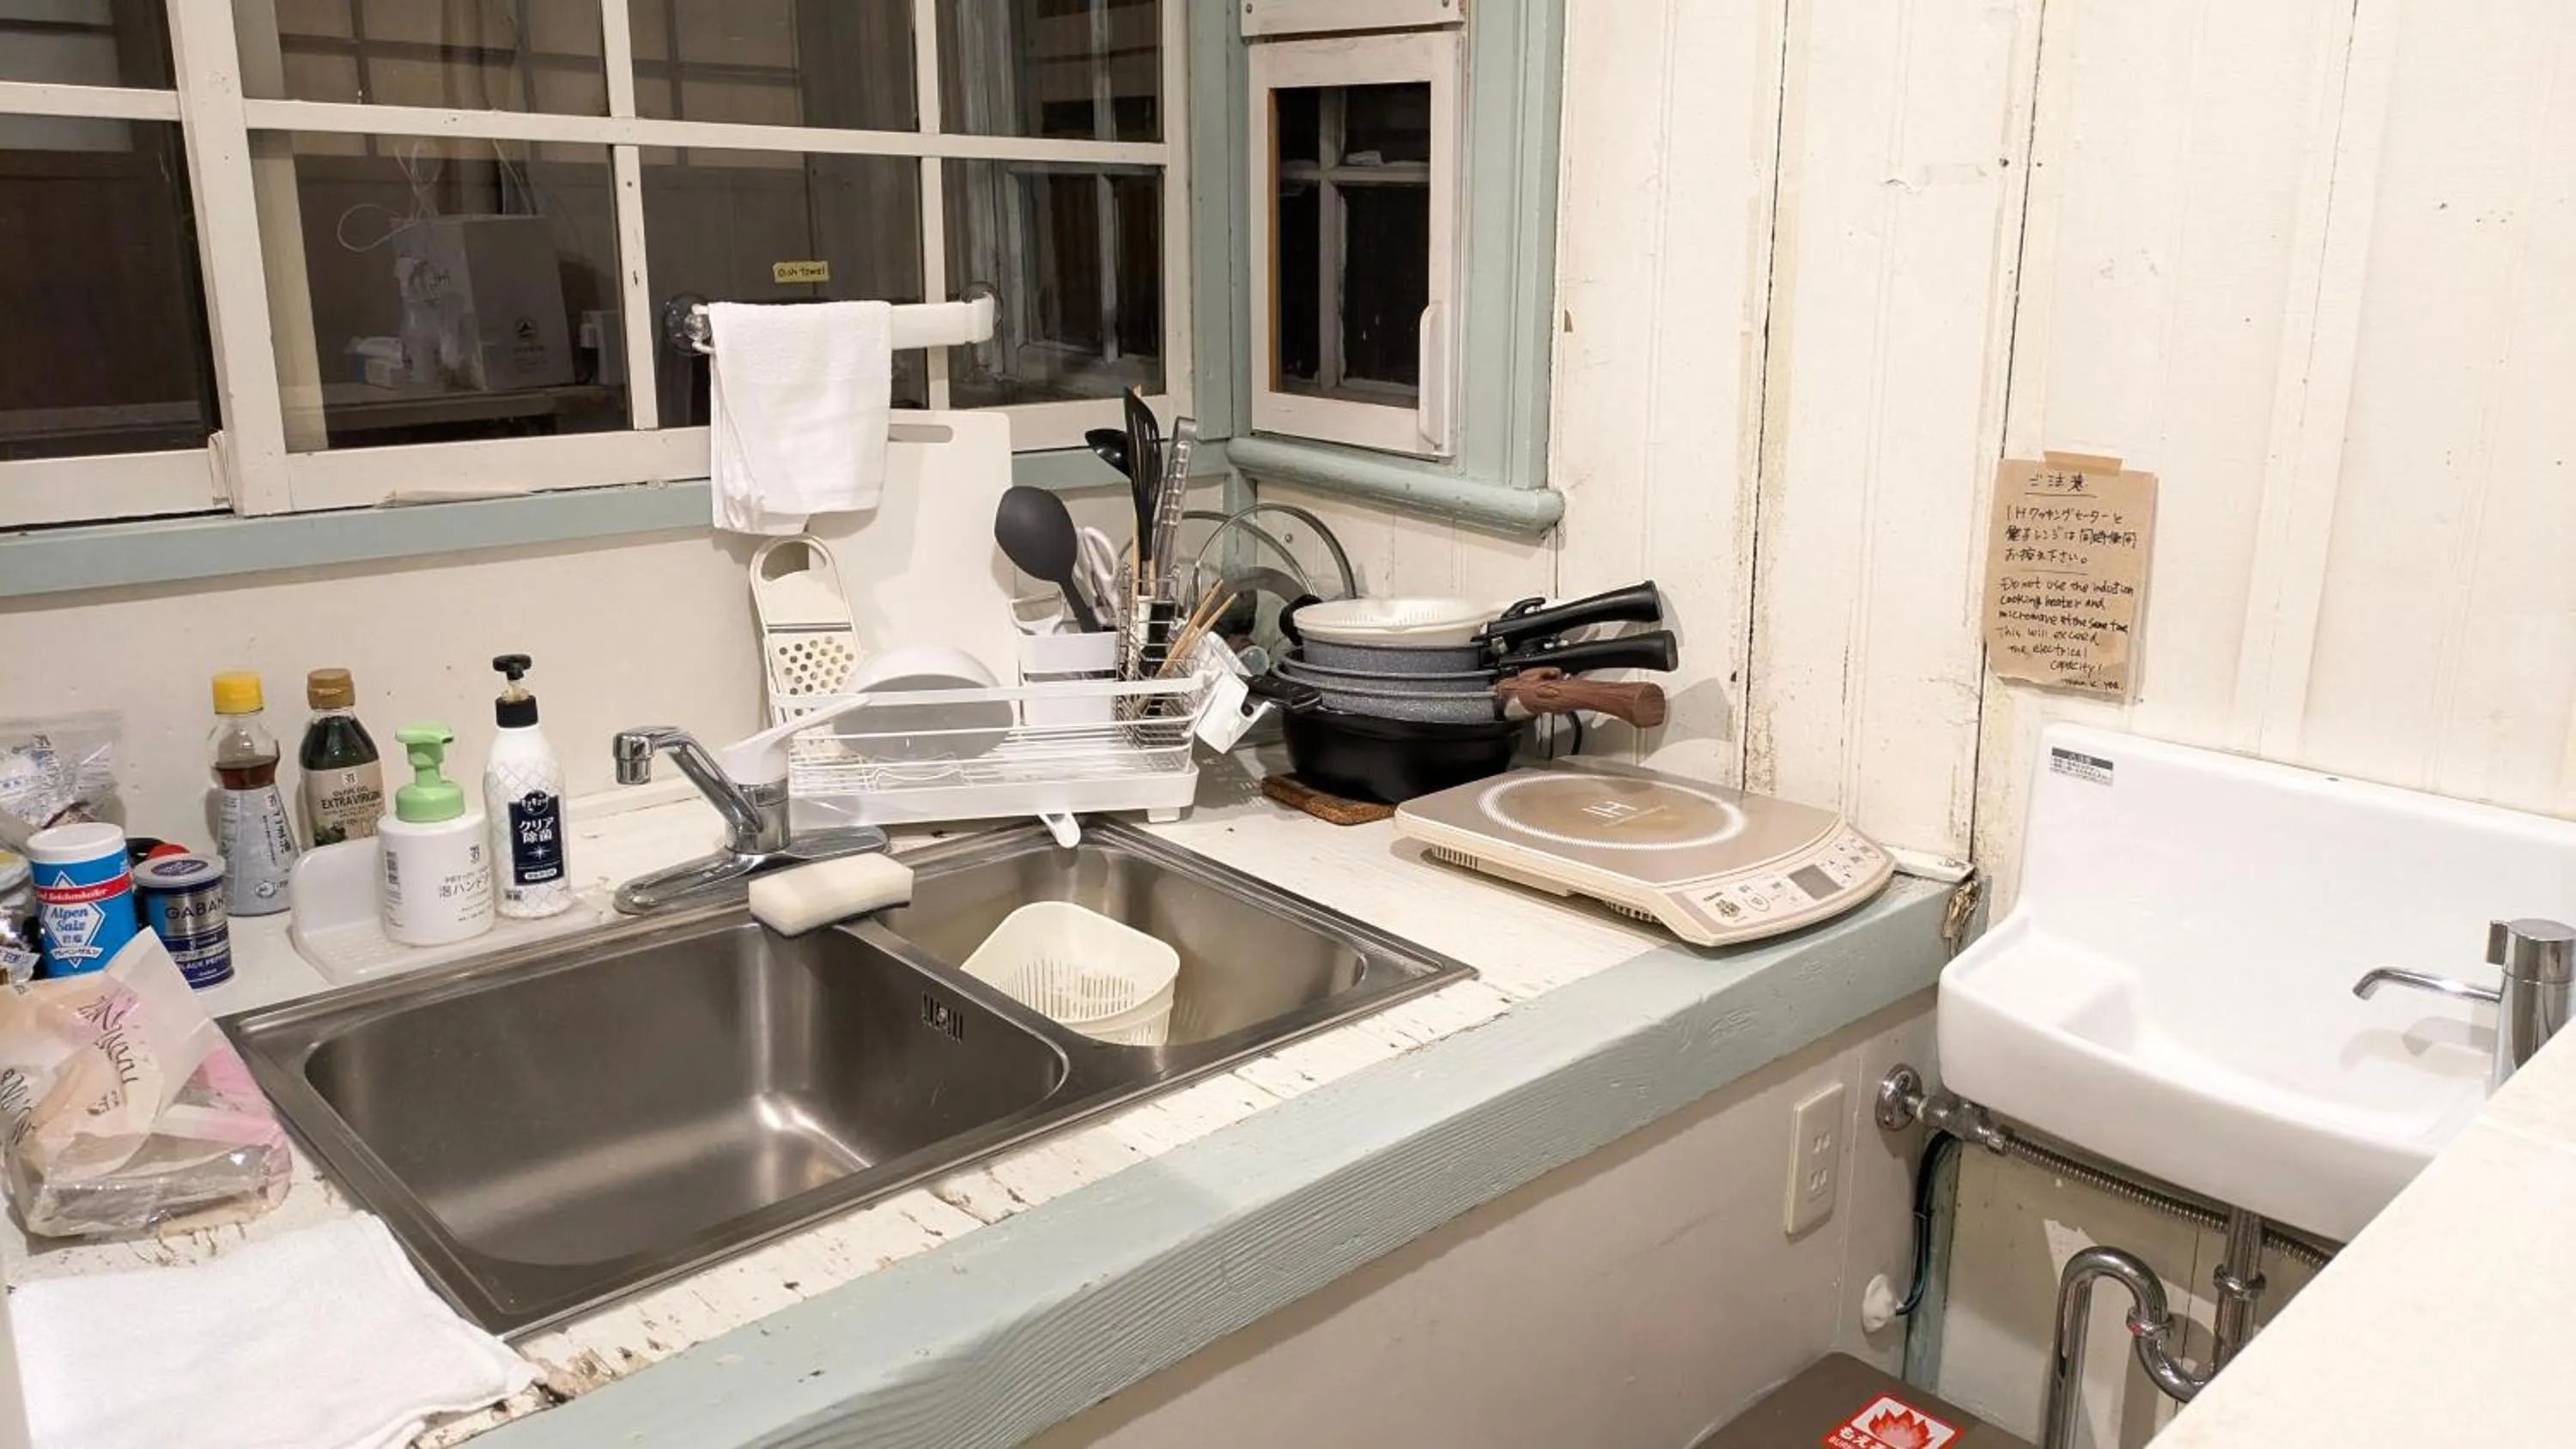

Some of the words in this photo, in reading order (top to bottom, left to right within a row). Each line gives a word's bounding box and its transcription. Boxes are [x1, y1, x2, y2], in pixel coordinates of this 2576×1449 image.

[2000, 576, 2019, 591] Do
[2022, 577, 2041, 590] not
[2046, 580, 2067, 591] use
[2070, 580, 2089, 592] the
[2045, 595, 2081, 608] heater
[2085, 597, 2105, 610] and
[1999, 610, 2058, 625] microwave
[1995, 626, 2020, 639] This
[2028, 627, 2048, 638] will
[2032, 643, 2087, 658] electrical
[519, 816, 554, 832] クリア
[521, 829, 552, 844] 除菌
[51, 907, 88, 921] Alpen
[56, 920, 86, 931] Salz
